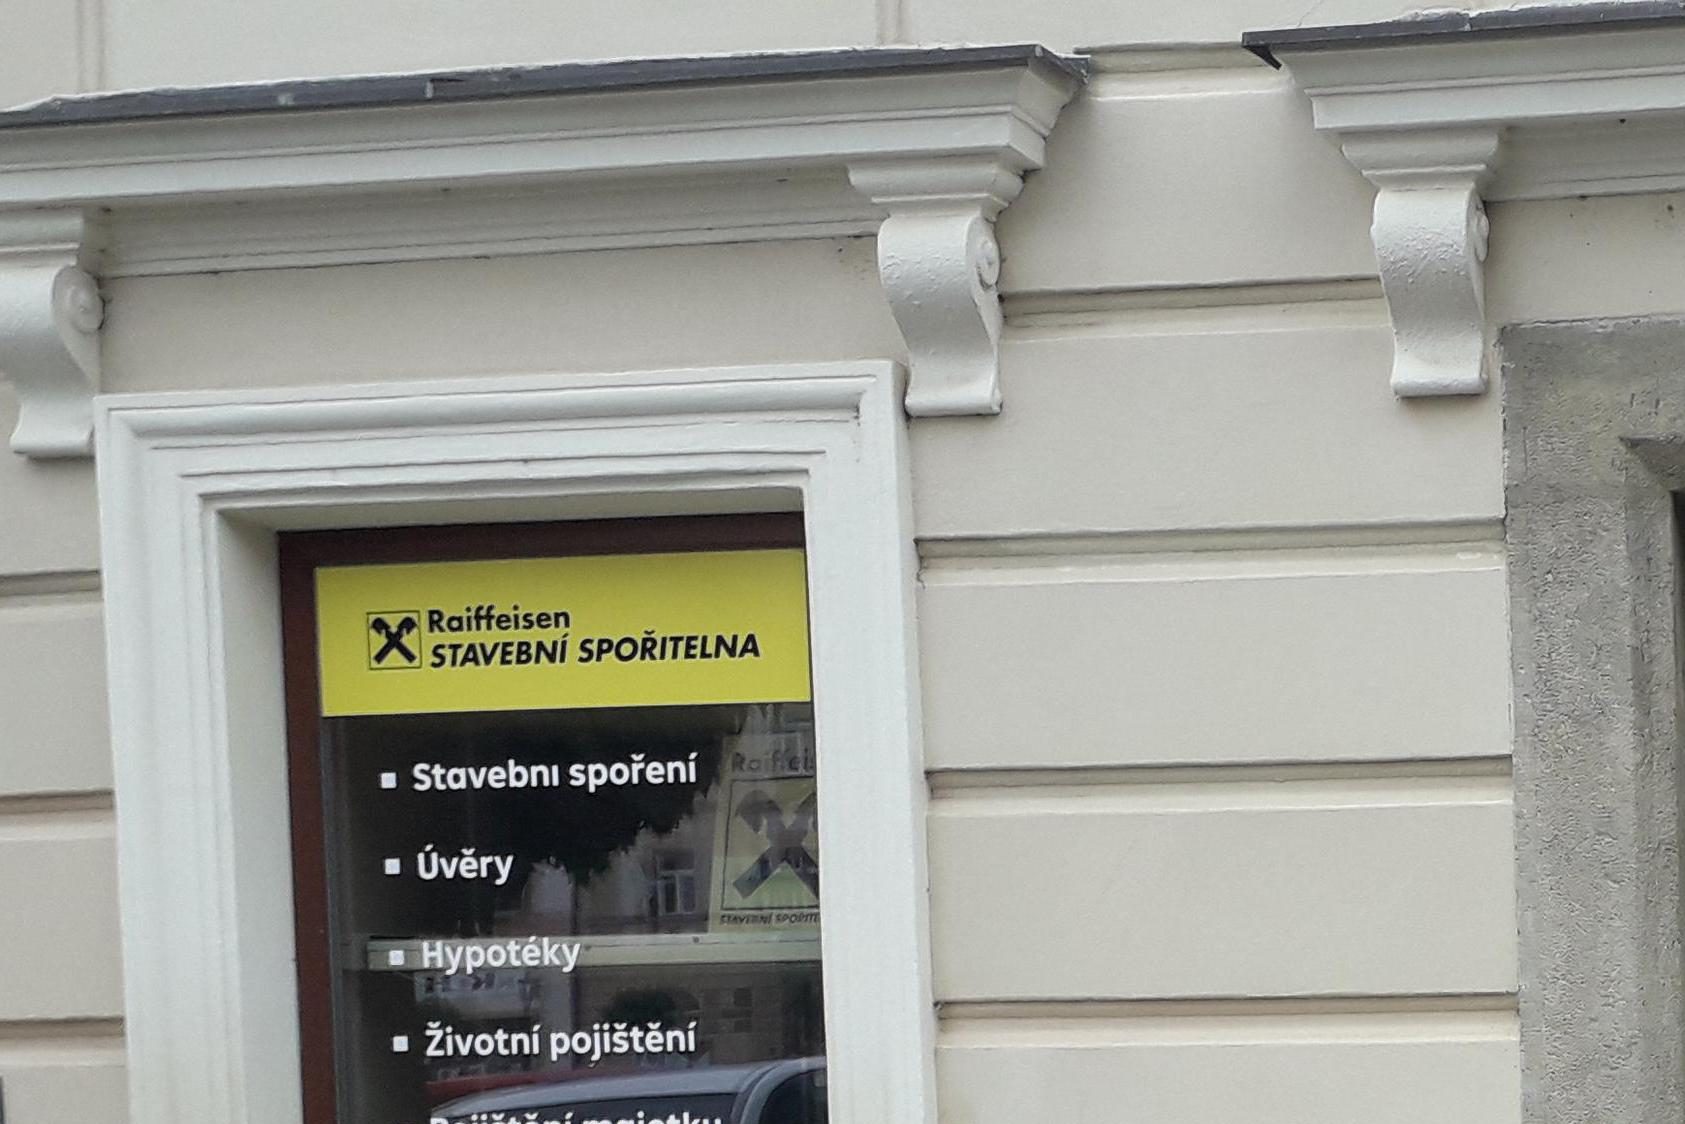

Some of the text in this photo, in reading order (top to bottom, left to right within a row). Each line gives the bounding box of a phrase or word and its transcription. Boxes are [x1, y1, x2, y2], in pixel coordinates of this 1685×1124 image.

[427, 604, 570, 633] Raiffeisen
[430, 629, 761, 669] STAVEBNÍ SPOŘITELNA
[569, 752, 699, 793] spoření
[417, 844, 514, 885] Úvěry
[421, 936, 581, 975] Hypotéky
[424, 1021, 697, 1062] Životní pojištění
